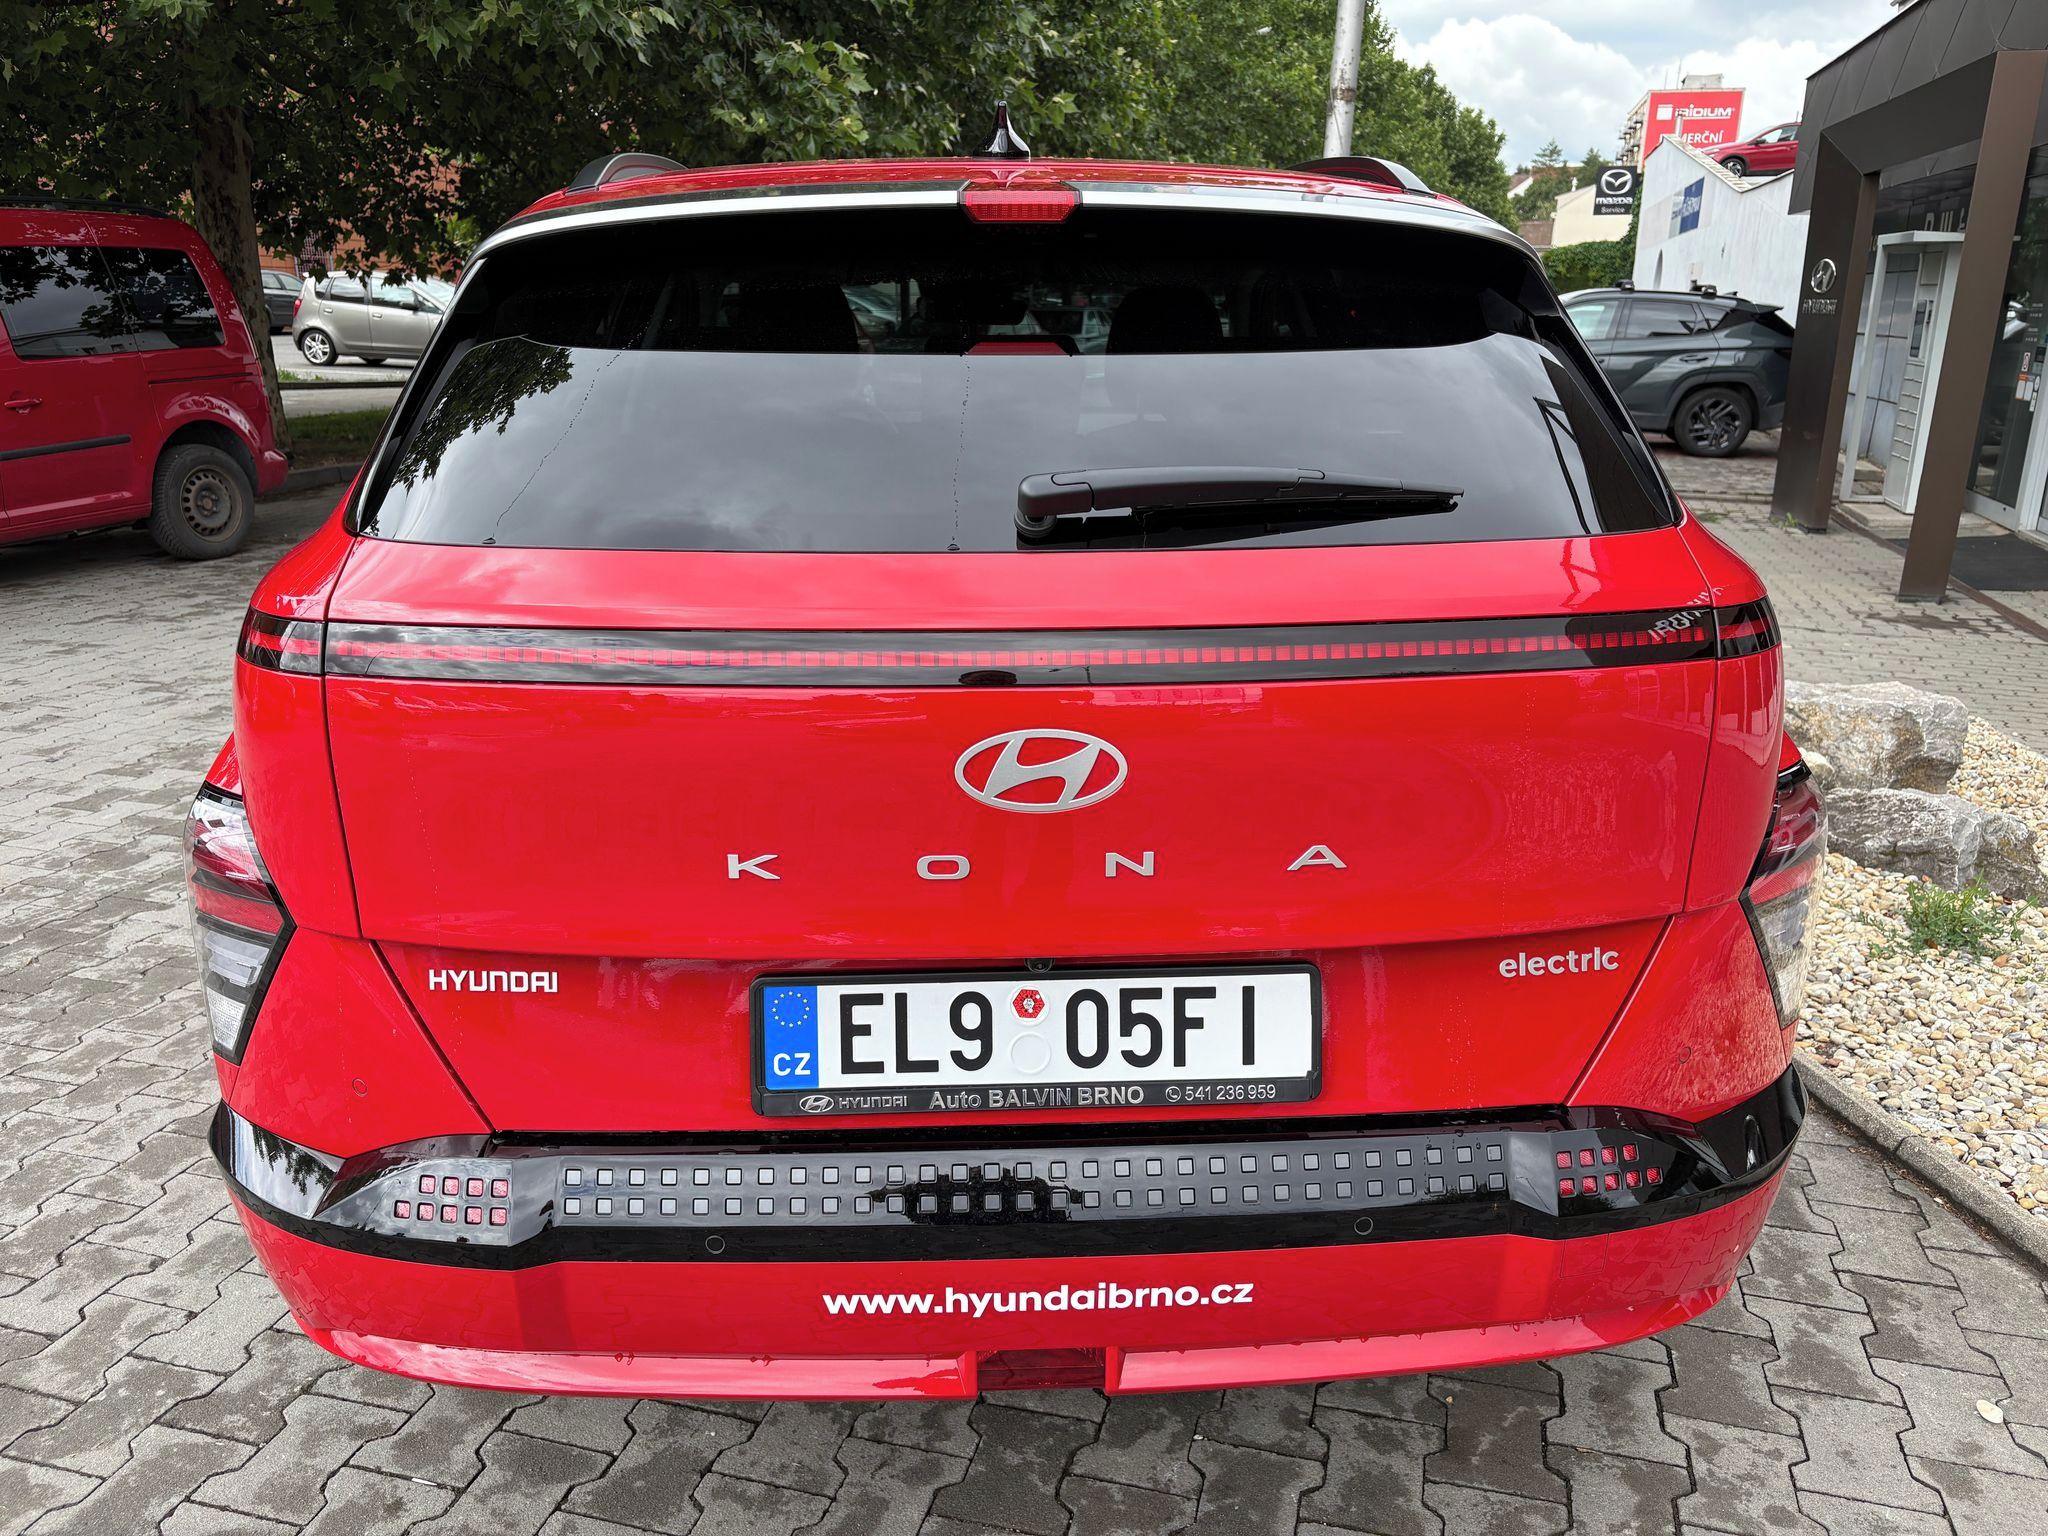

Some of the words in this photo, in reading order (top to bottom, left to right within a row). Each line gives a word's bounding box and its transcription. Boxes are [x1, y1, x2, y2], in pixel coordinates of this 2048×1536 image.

[1601, 206, 1625, 214] Service
[726, 844, 1347, 881] KONA
[1499, 946, 1619, 978] electric
[428, 969, 558, 994] HYUNDAI
[839, 990, 993, 1075] EL9
[773, 1053, 811, 1077] CZ
[838, 1095, 908, 1109] HYUNDAI
[929, 1091, 982, 1109] Auto
[989, 1088, 1071, 1108] BALVIN
[1077, 1085, 1144, 1106] BRNO
[1184, 1085, 1211, 1101] 541
[1216, 1085, 1245, 1100] 236
[1247, 1084, 1276, 1099] 959
[822, 1281, 1255, 1318] www.hyundaibrno.cz
